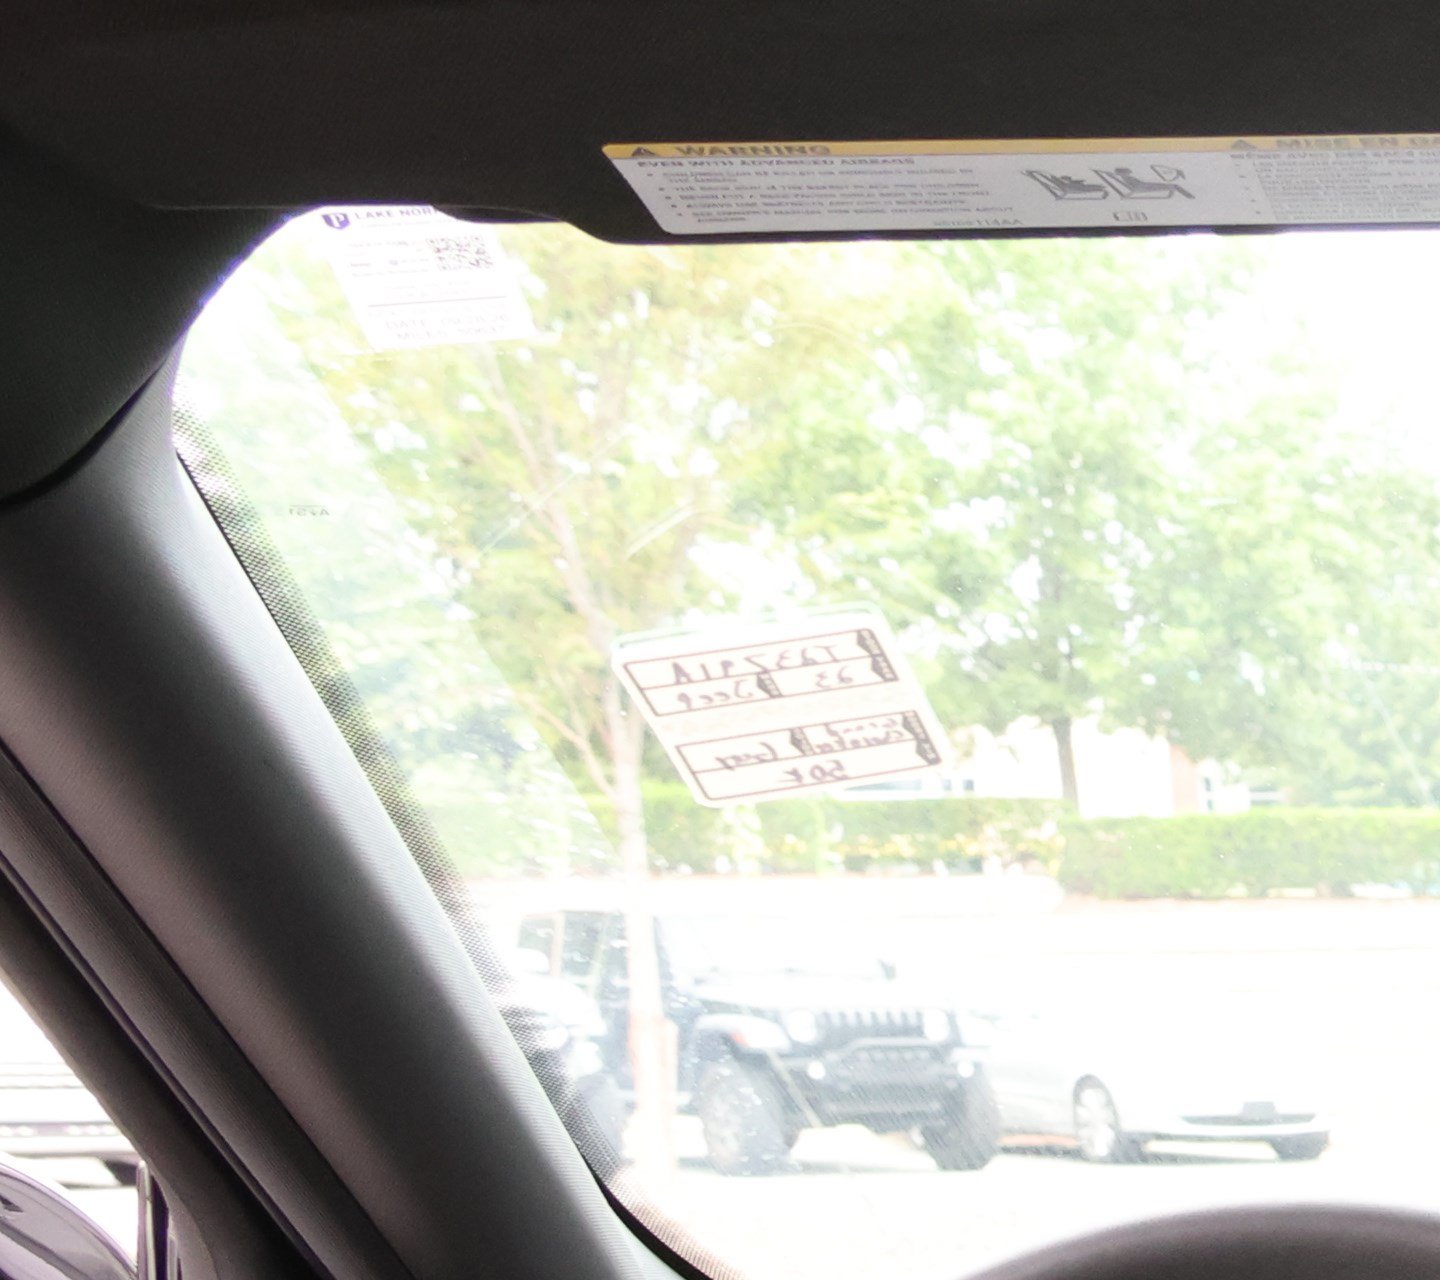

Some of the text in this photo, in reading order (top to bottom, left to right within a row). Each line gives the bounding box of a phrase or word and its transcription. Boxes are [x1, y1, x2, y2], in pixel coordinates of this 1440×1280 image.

[674, 144, 832, 157] WARNING
[1275, 139, 1351, 150] MISE
[1358, 138, 1400, 148] EN
[354, 205, 393, 220] LAKE
